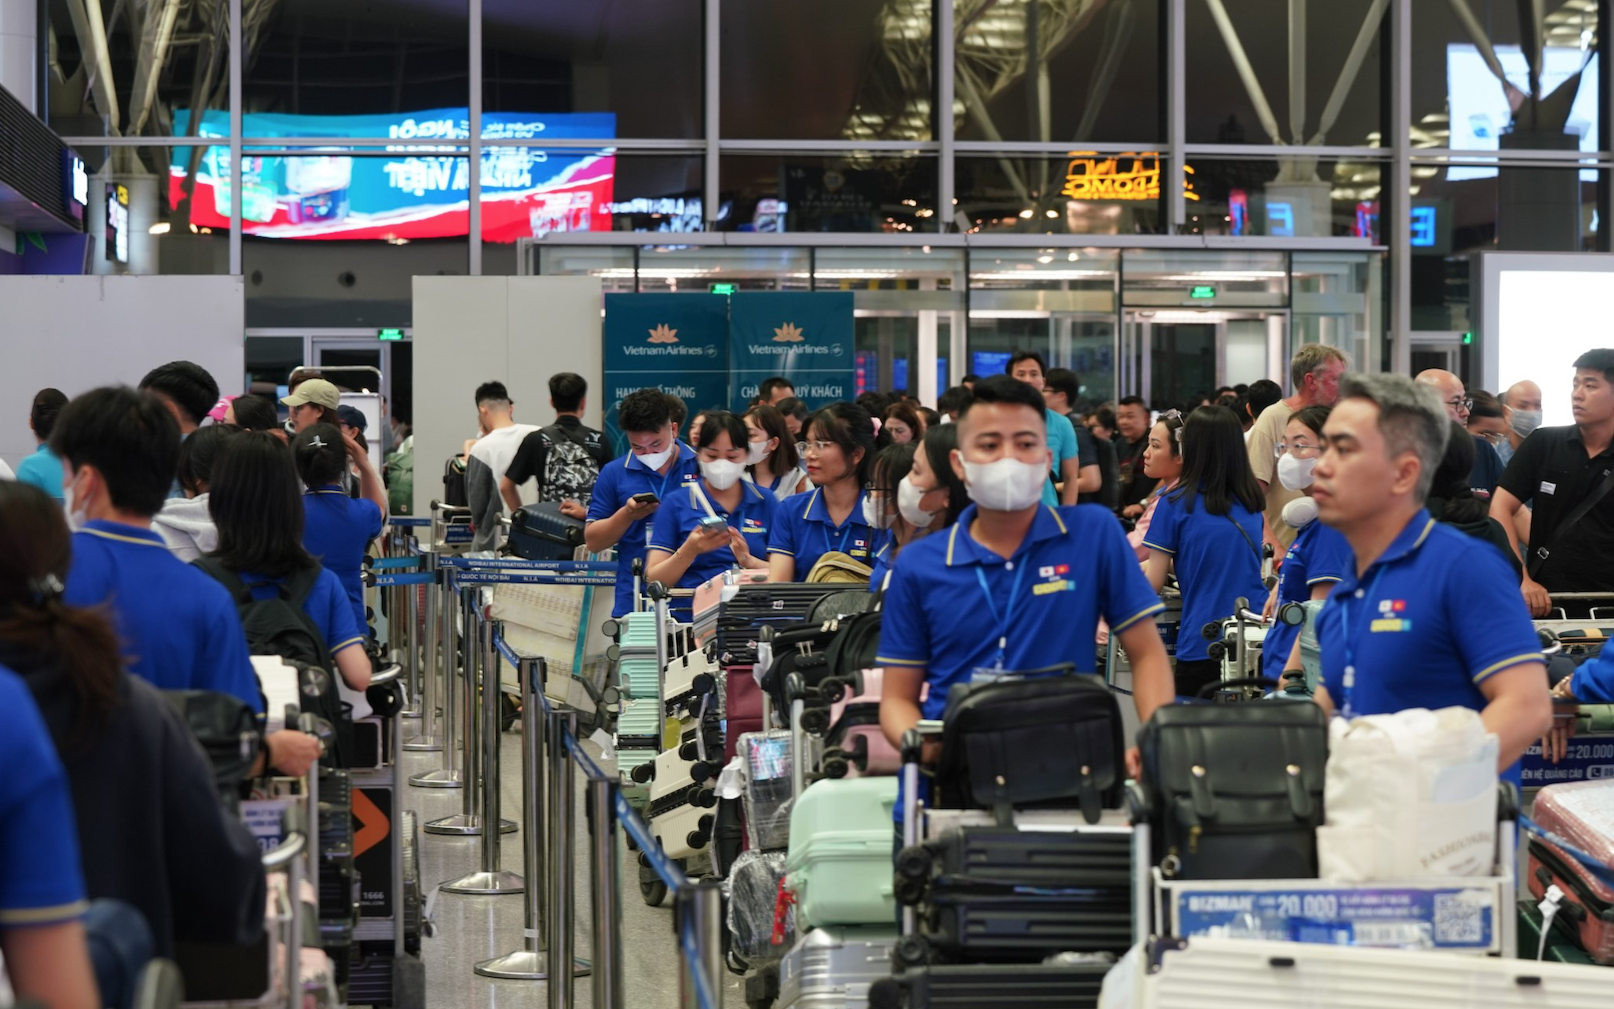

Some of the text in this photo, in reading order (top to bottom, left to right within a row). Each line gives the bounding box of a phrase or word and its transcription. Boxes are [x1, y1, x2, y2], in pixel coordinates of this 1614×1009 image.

[623, 345, 703, 356] Vietnam Airlines
[748, 344, 829, 355] Vietnam Airlines
[811, 384, 843, 398] KHÁCH
[489, 561, 534, 569] INTERNATIONAL
[1576, 744, 1614, 759] 20.000
[1568, 767, 1583, 779] CÁO
[363, 891, 385, 900] 1666
[1277, 894, 1337, 918] 20.000
